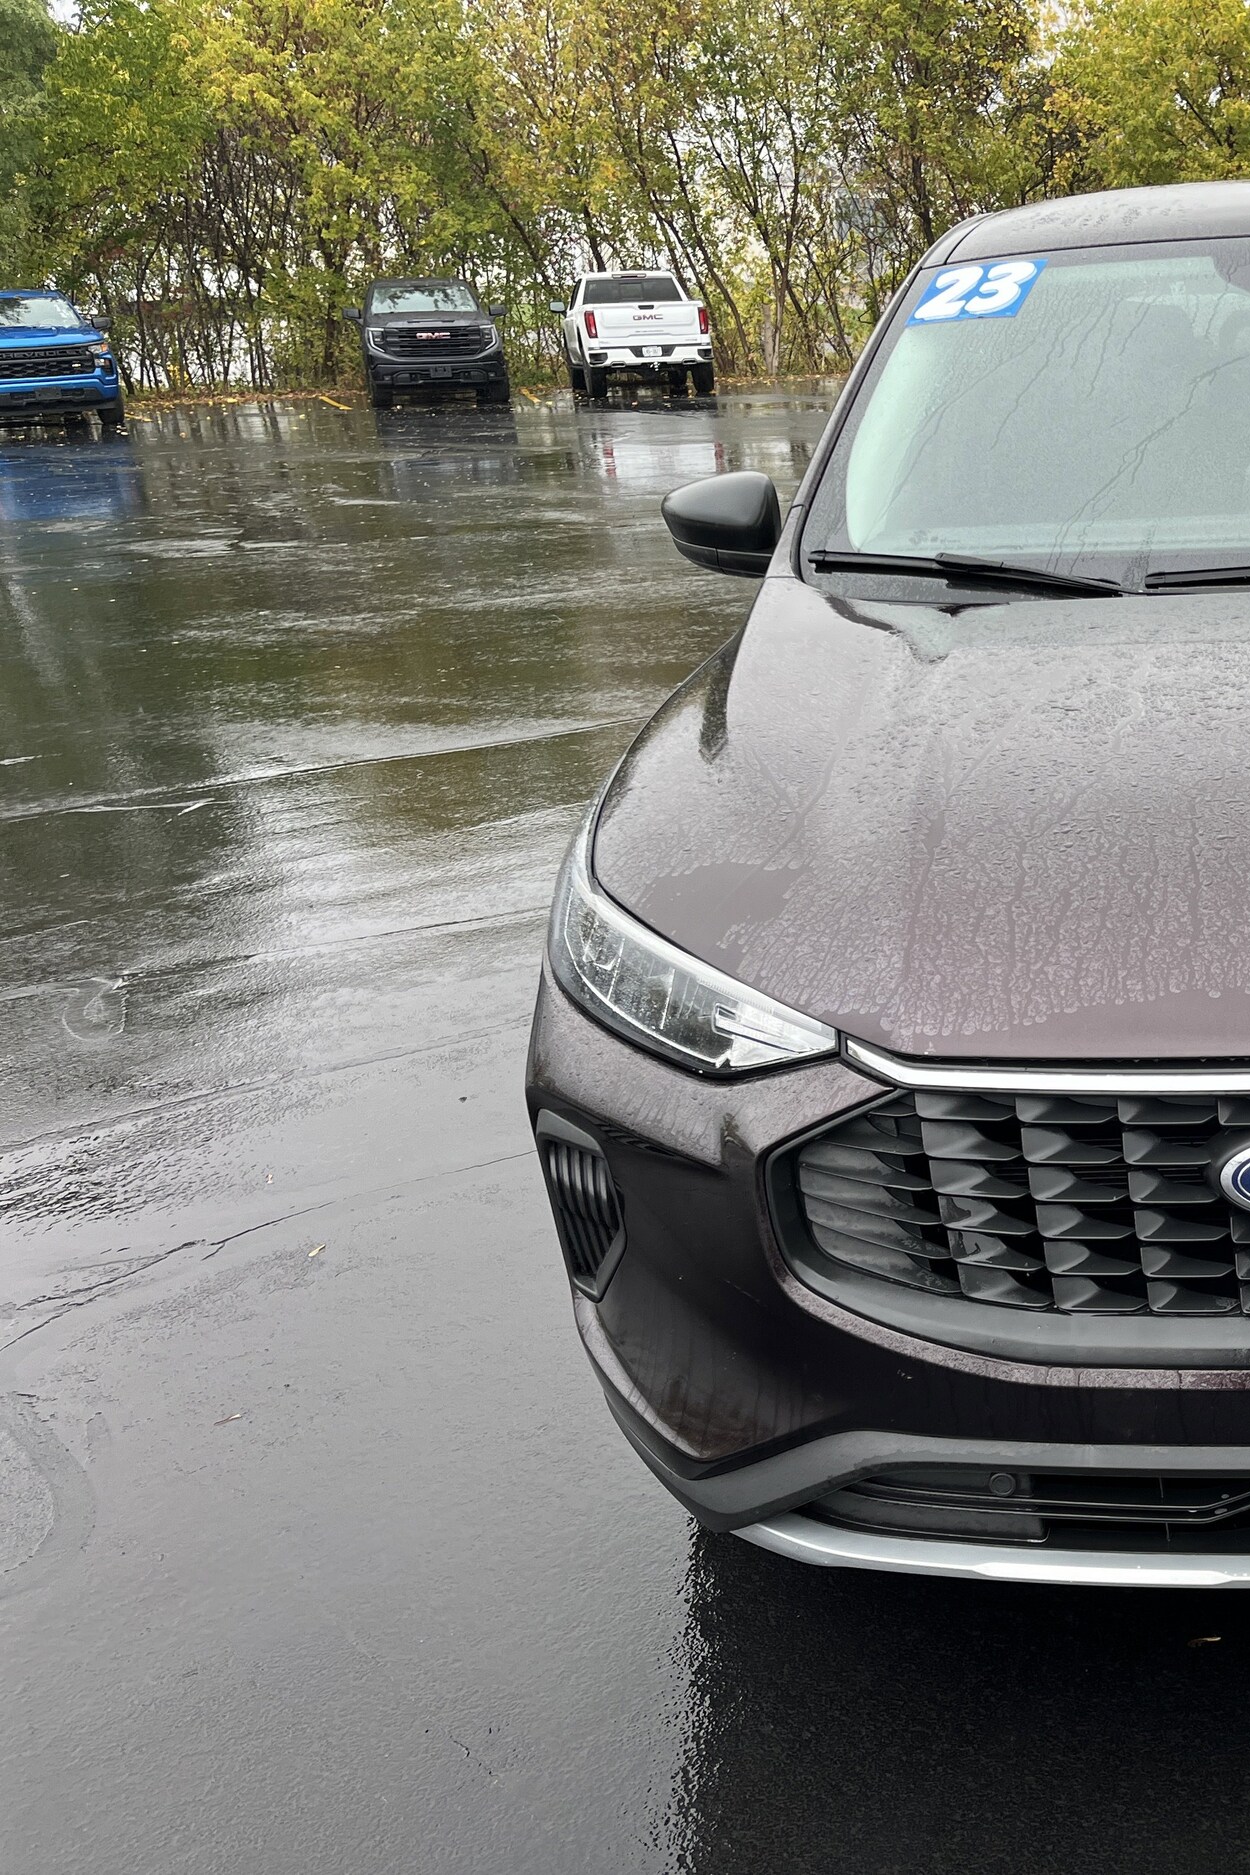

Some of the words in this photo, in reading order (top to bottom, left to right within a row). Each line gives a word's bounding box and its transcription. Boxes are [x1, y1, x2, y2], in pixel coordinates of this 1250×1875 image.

[913, 261, 1037, 321] 23
[632, 313, 664, 321] GMC
[415, 332, 451, 340] GMC
[0, 348, 82, 359] HEVROLET
